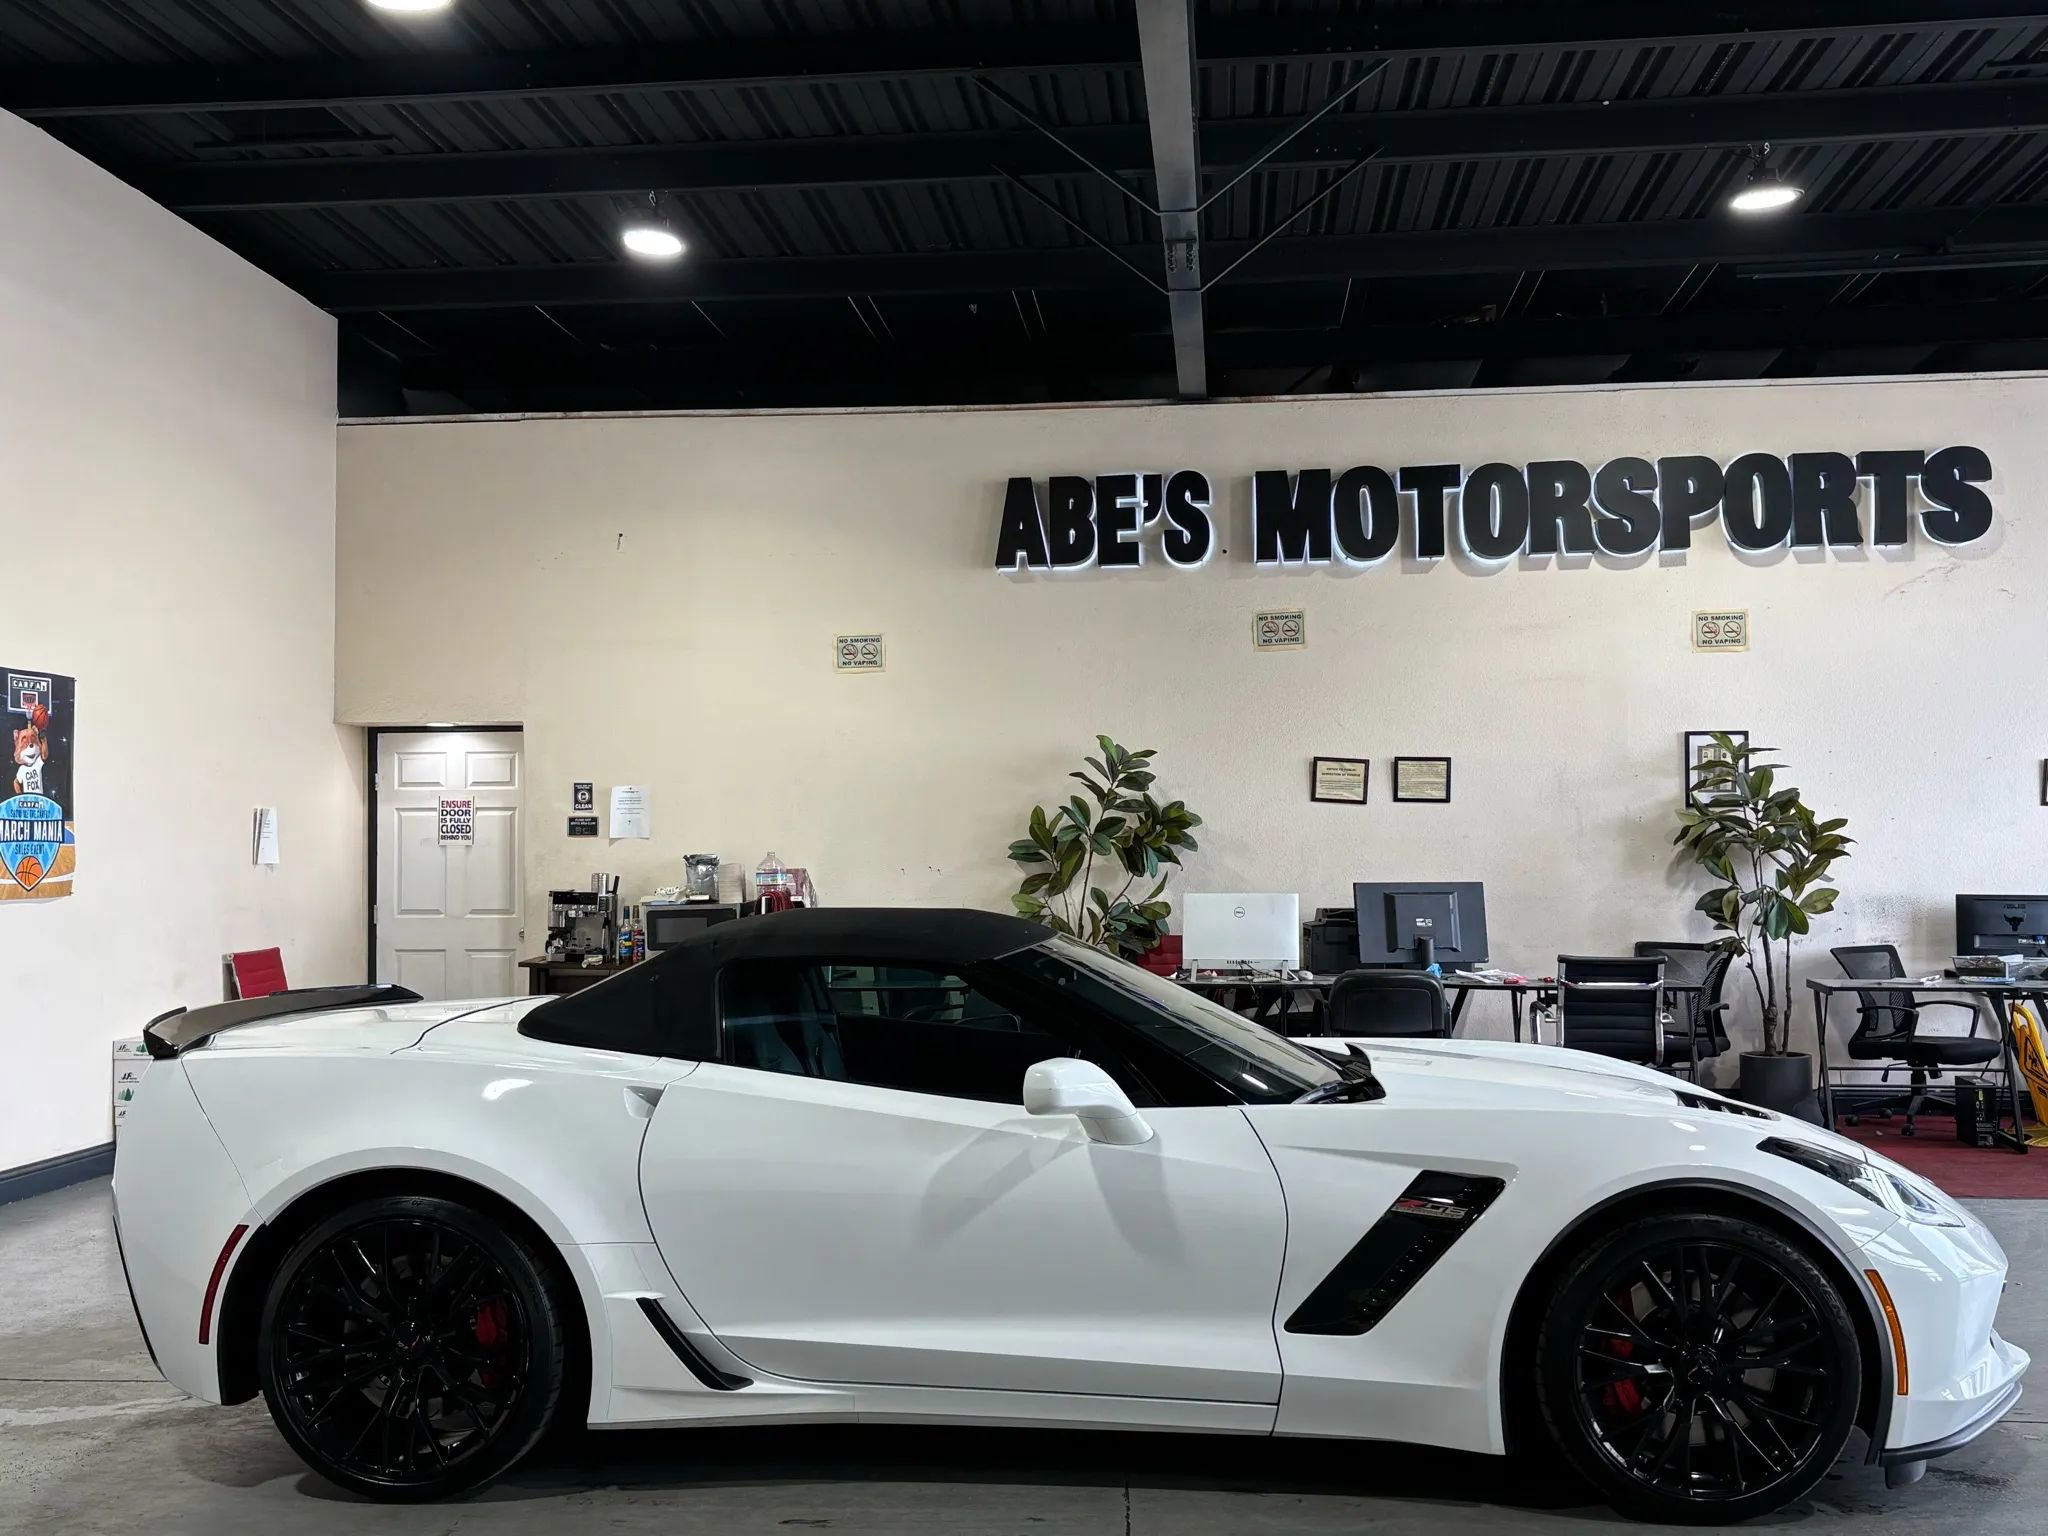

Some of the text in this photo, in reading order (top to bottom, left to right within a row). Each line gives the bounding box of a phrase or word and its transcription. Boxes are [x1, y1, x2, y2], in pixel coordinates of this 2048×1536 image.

[995, 446, 1994, 569] ABE'S MOTORSPORTS
[25, 769, 39, 780] CAR
[26, 780, 40, 790] FOX
[441, 800, 472, 808] ENSURE
[440, 809, 471, 817] DOOR
[33, 820, 63, 842] MANIA
[440, 824, 472, 834] CLOSED
[15, 844, 45, 855] SALES EVENT
